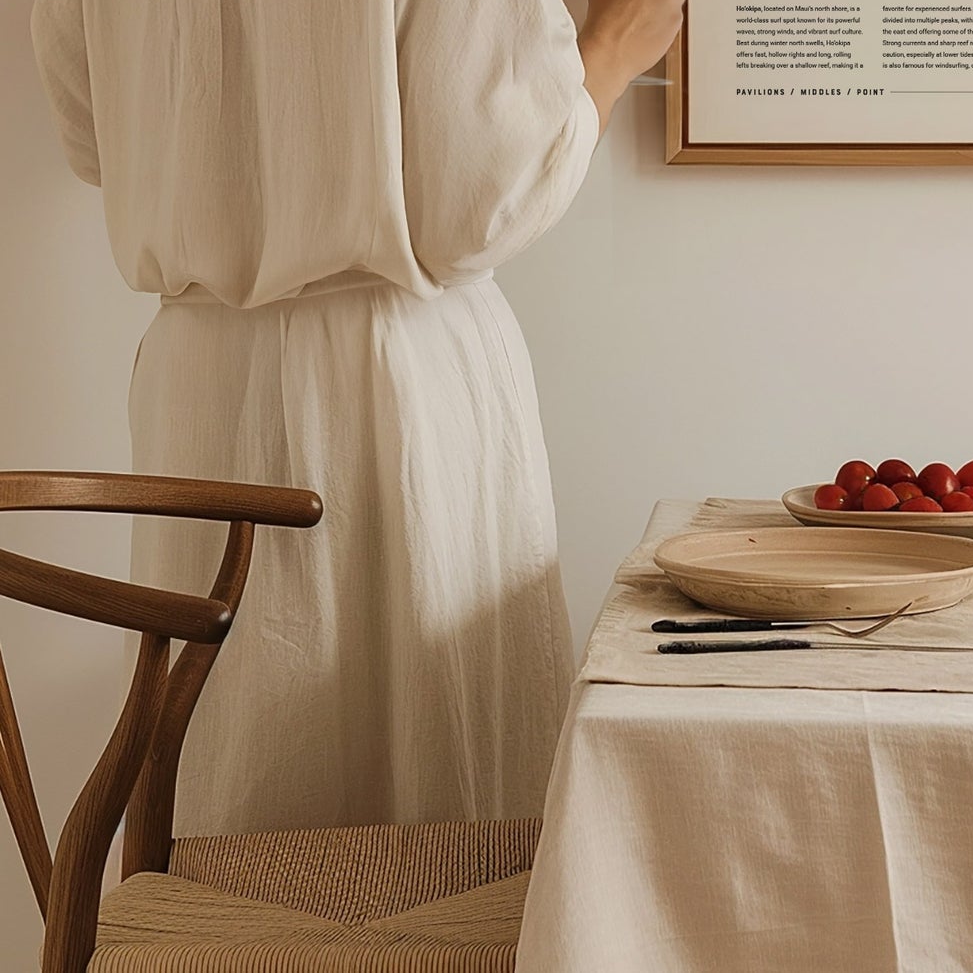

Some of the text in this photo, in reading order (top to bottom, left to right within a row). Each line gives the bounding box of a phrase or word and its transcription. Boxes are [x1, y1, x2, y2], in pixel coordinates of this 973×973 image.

[918, 28, 942, 36] offering
[818, 51, 832, 59] long,
[833, 51, 852, 59] rolling
[906, 51, 935, 59] especially
[750, 62, 776, 70] breaking
[832, 62, 854, 70] making
[934, 62, 970, 70] windsurfing,
